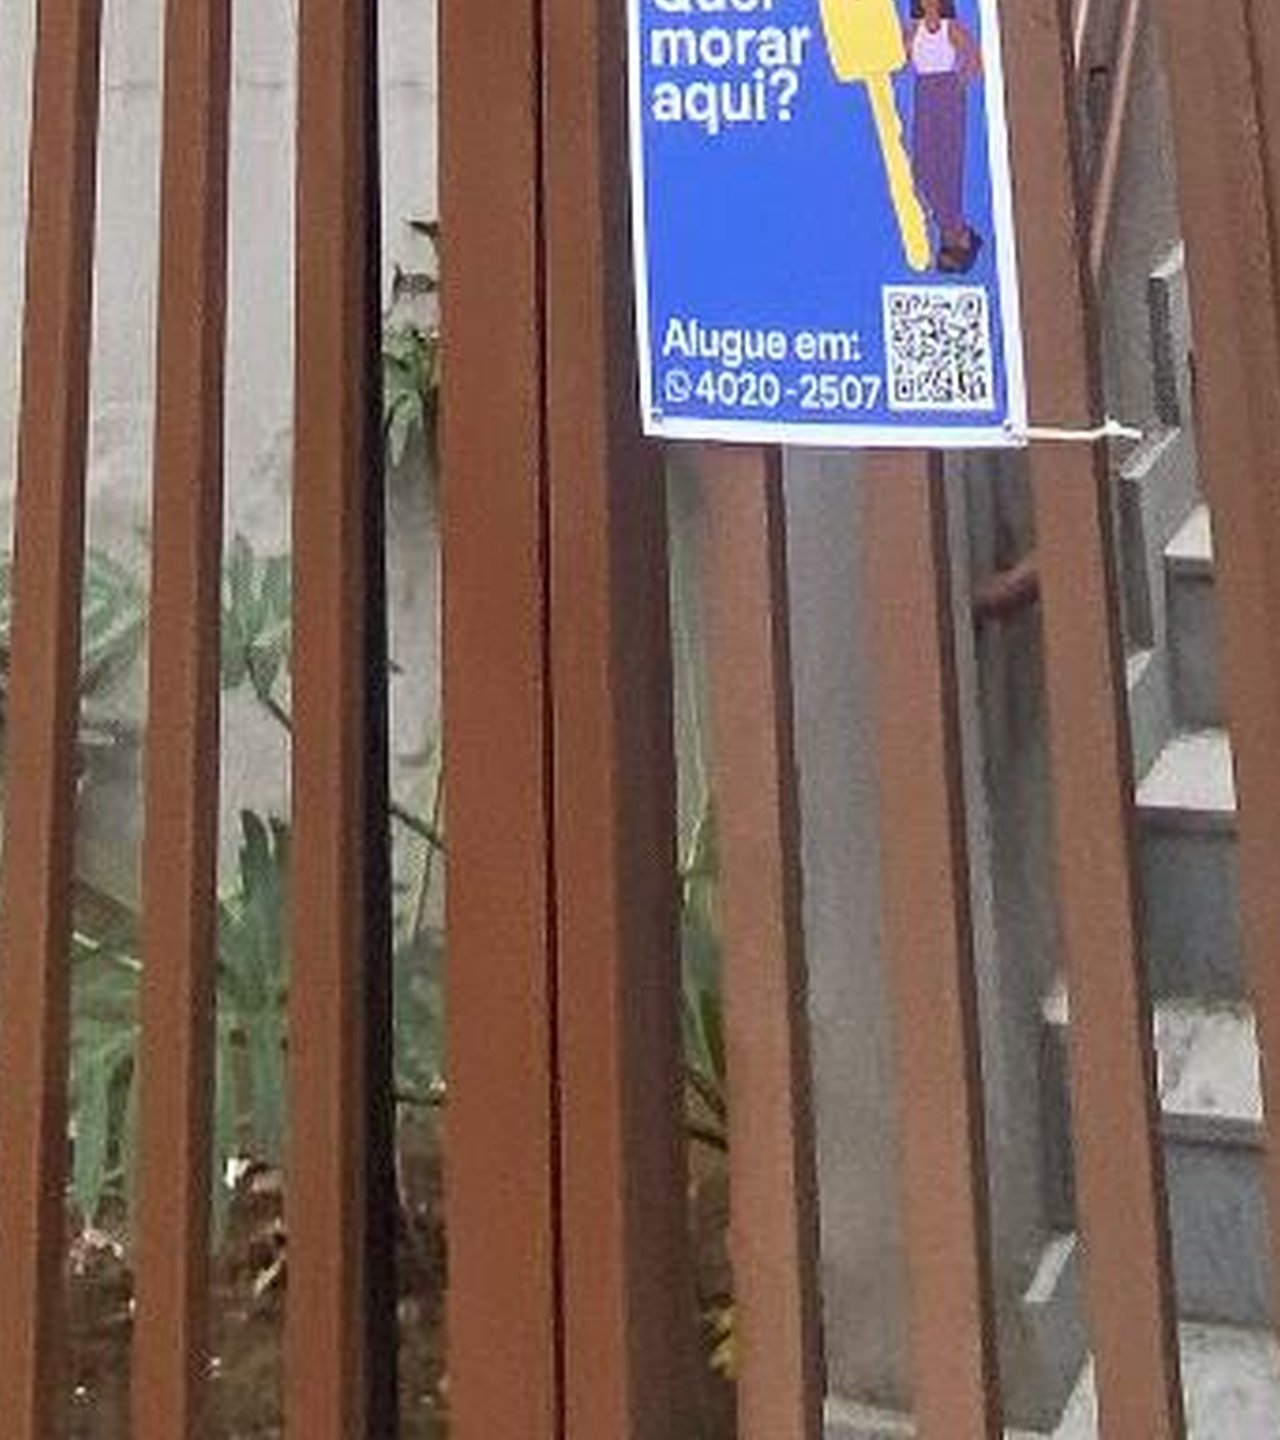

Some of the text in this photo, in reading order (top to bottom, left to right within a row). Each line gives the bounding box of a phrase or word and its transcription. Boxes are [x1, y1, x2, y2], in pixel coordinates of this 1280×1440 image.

[650, 24, 810, 68] morar
[652, 69, 799, 134] aqui?
[662, 318, 861, 368] Alugue em:
